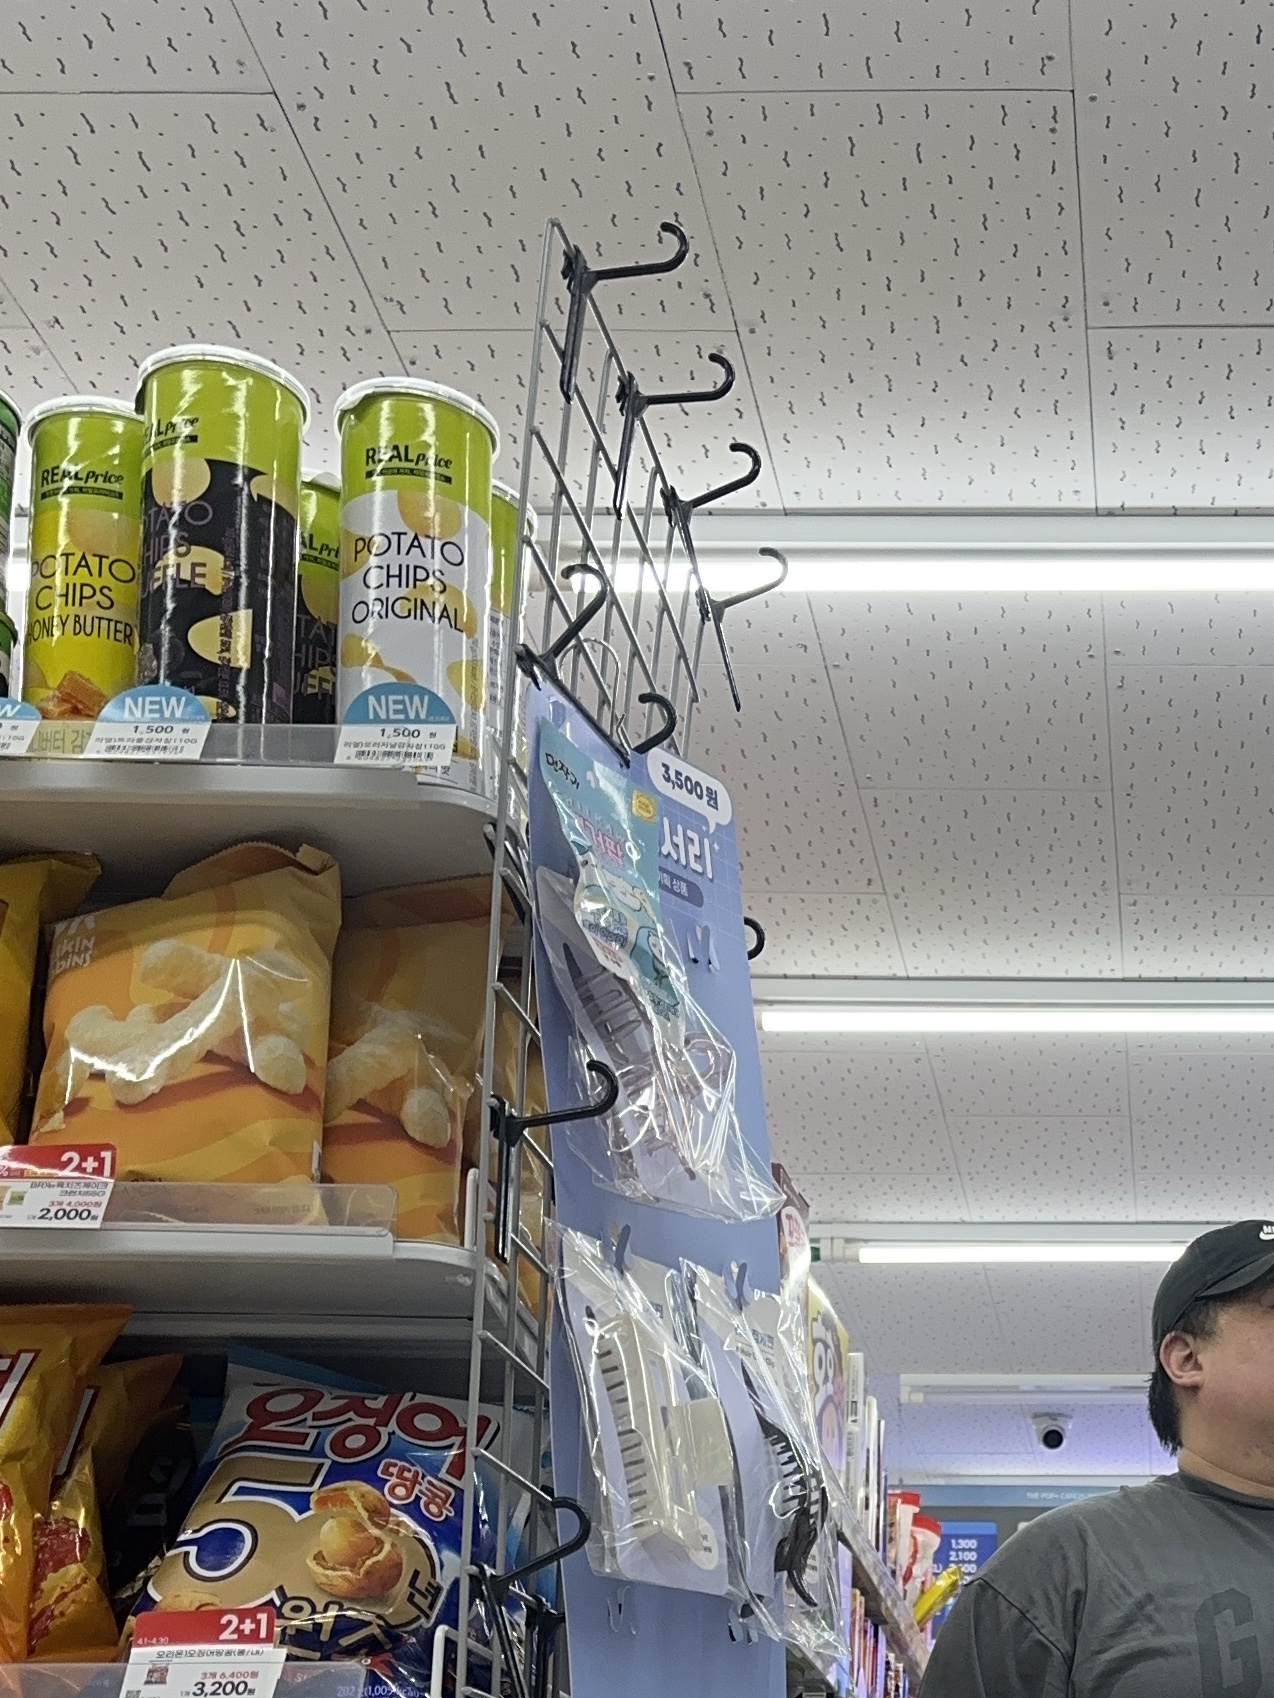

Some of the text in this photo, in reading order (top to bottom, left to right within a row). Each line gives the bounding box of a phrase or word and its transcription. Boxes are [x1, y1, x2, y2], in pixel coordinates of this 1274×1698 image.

[354, 531, 464, 567] POTATO
[31, 553, 136, 582] POTATO
[363, 565, 447, 593] CHIPS
[35, 582, 115, 611] CHIPS
[351, 596, 463, 632] ORIGINAL
[72, 618, 134, 646] BUTTER
[124, 696, 187, 718] NEW
[369, 695, 429, 719] NEW
[61, 1151, 112, 1178] 2+1
[221, 1389, 492, 1482] 오징어
[381, 1461, 454, 1521] 땅콩
[219, 1613, 268, 1641] 2+1
